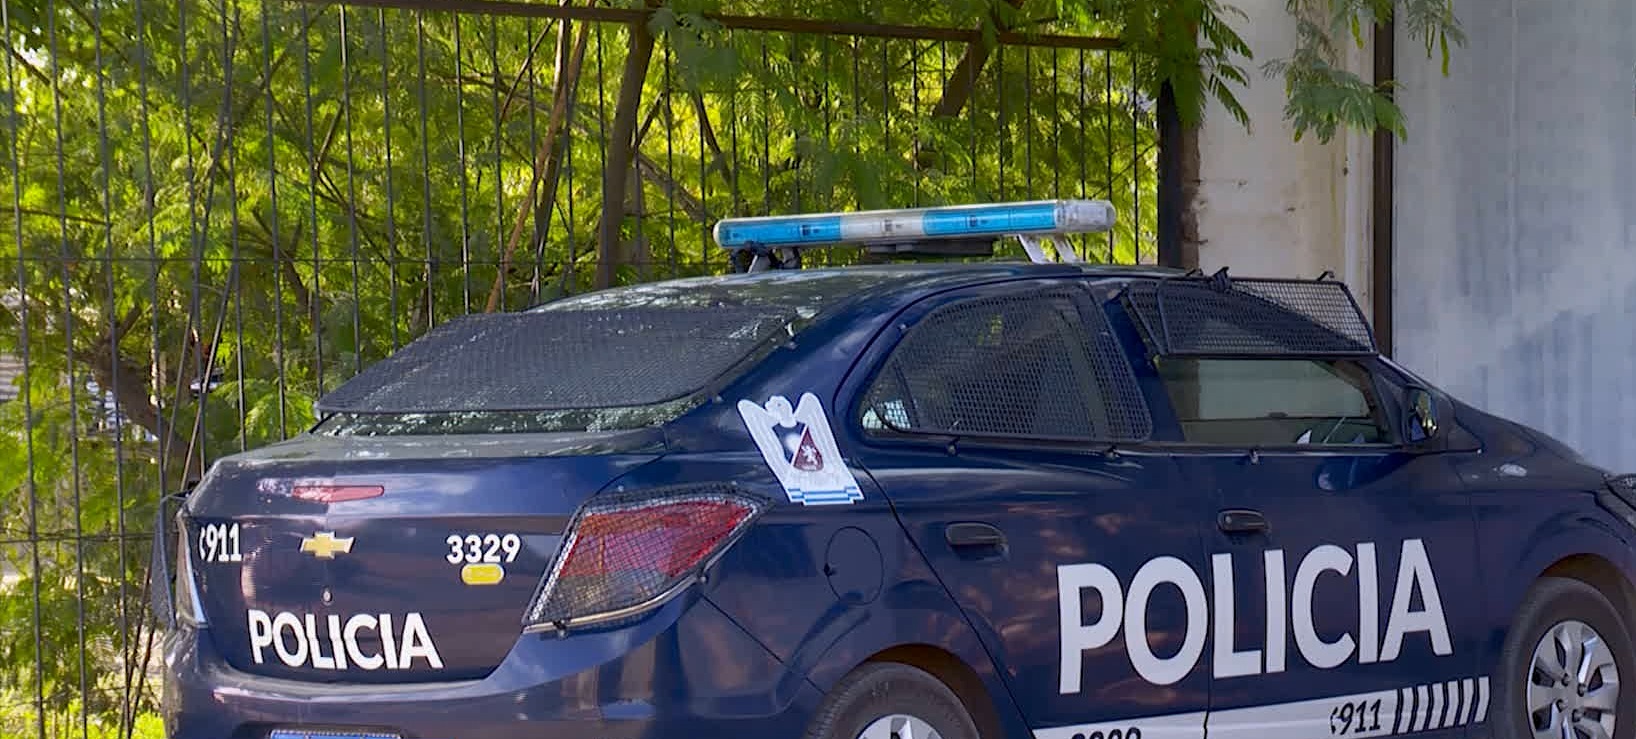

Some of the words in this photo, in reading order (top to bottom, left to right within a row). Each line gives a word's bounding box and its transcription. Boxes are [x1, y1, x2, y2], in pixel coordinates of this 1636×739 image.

[206, 523, 242, 562] 911
[446, 533, 521, 565] 3329
[1056, 538, 1454, 694] POLICIA
[247, 609, 444, 670] POLICIA
[1339, 699, 1381, 735] 911
